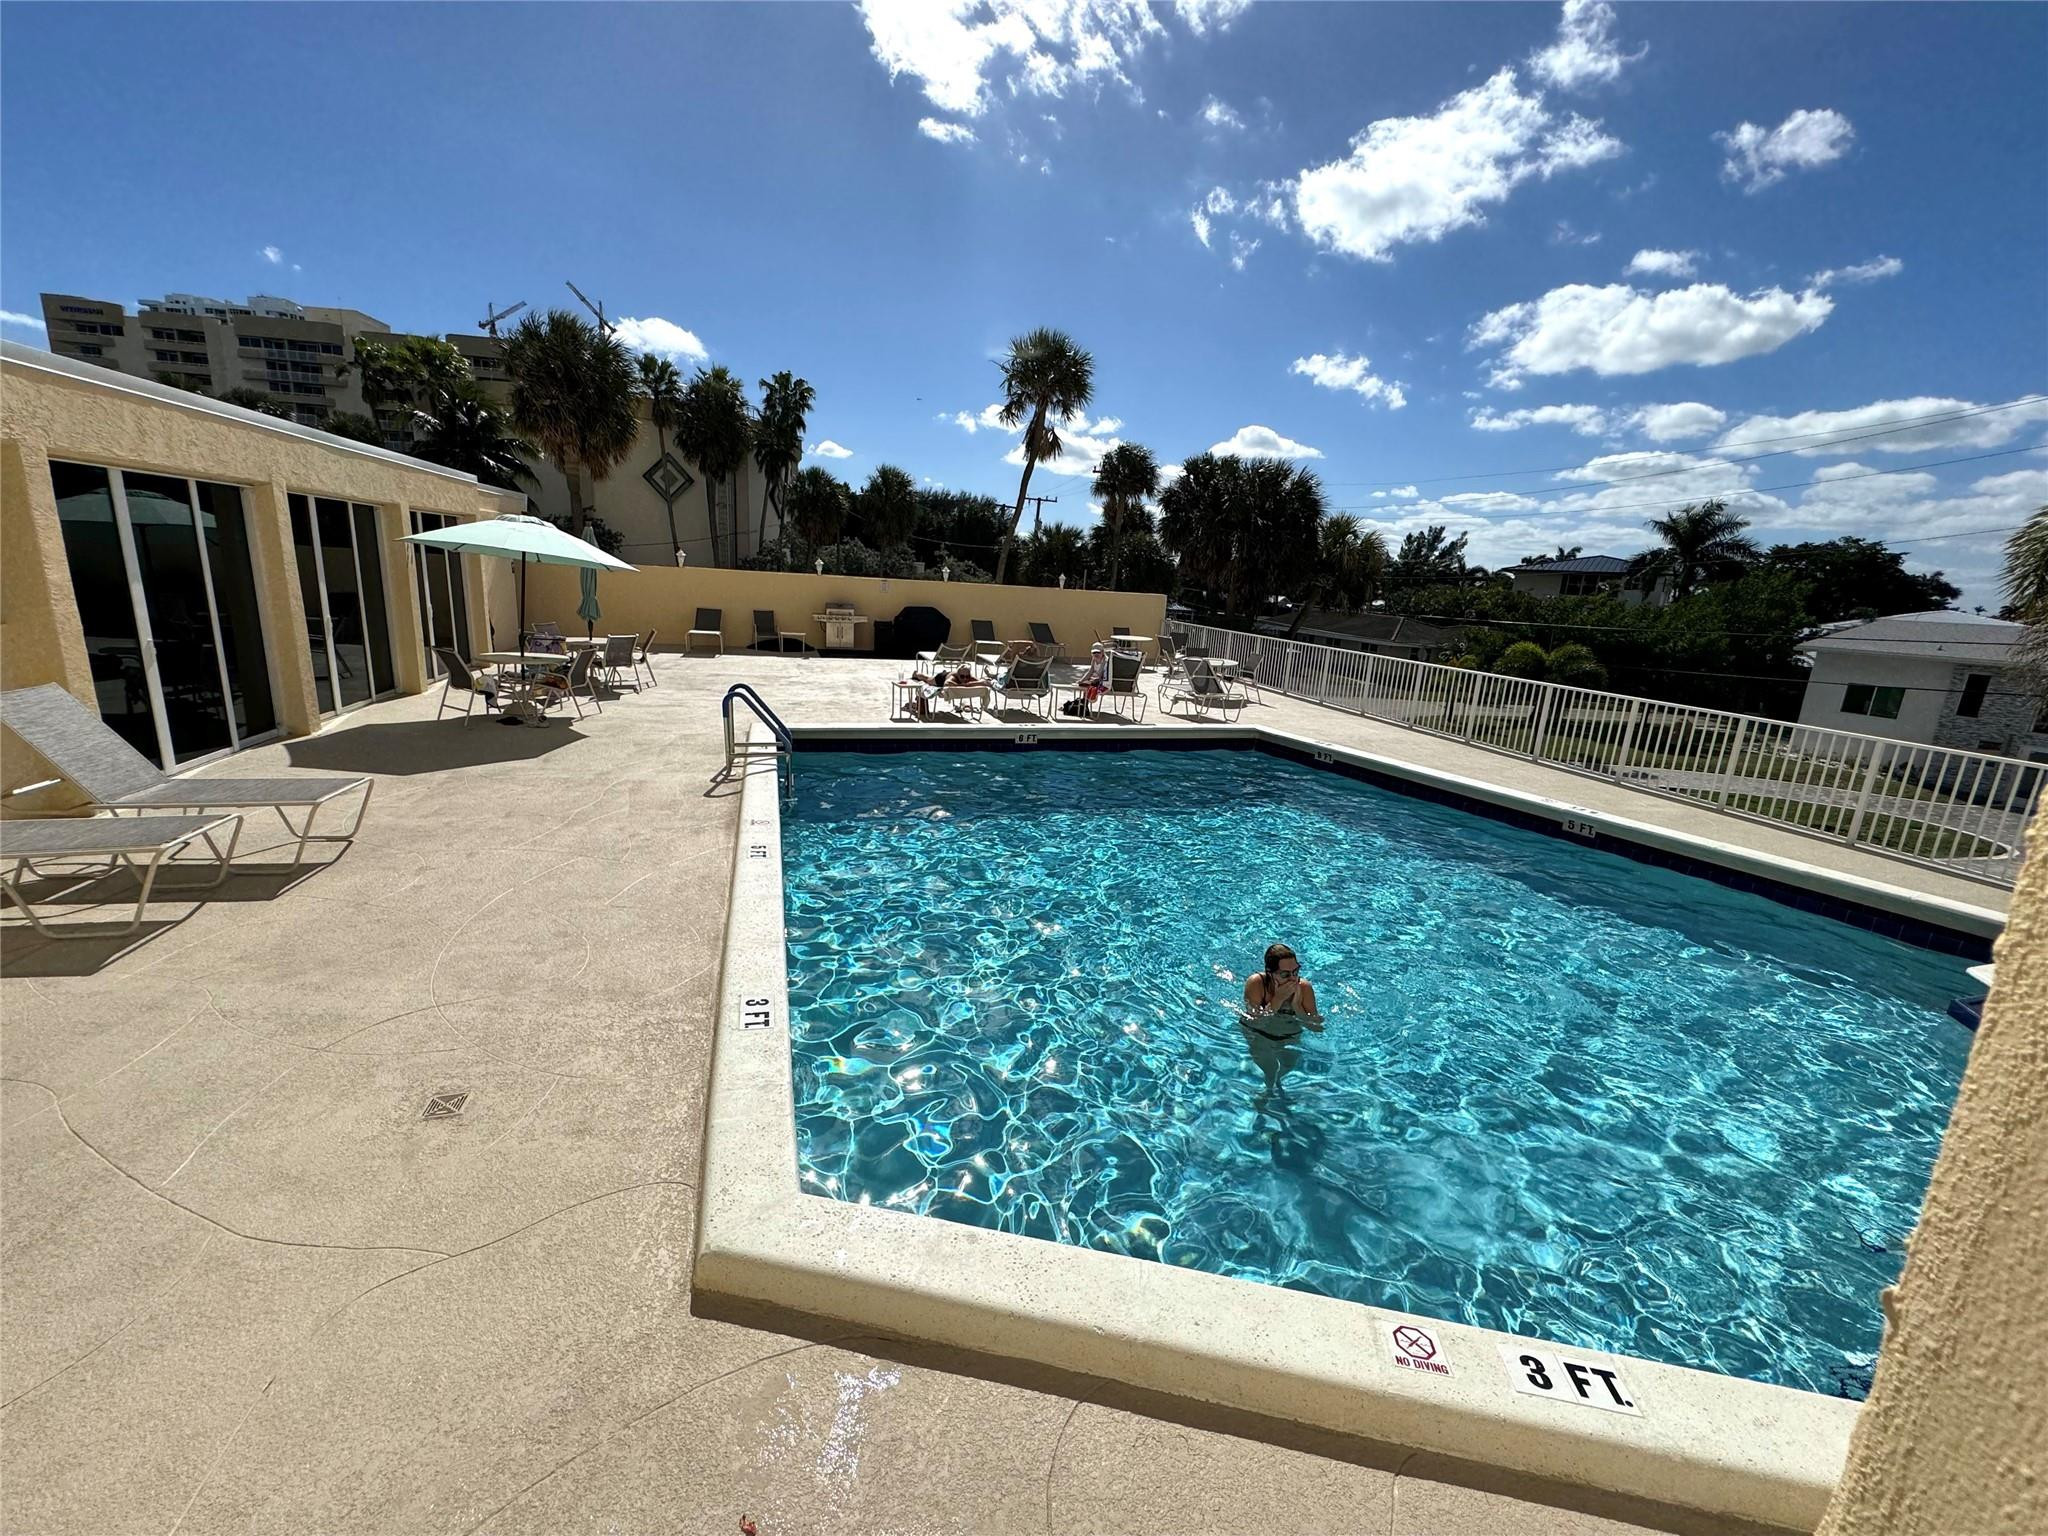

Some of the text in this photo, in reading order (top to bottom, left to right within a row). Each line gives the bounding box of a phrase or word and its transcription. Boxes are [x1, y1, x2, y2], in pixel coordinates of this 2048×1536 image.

[1567, 820, 1575, 830] 5
[744, 999, 770, 1029] 3 FT.
[1395, 1355, 1450, 1376] NO DIVING
[1519, 1354, 1635, 1408] 3 FT.
